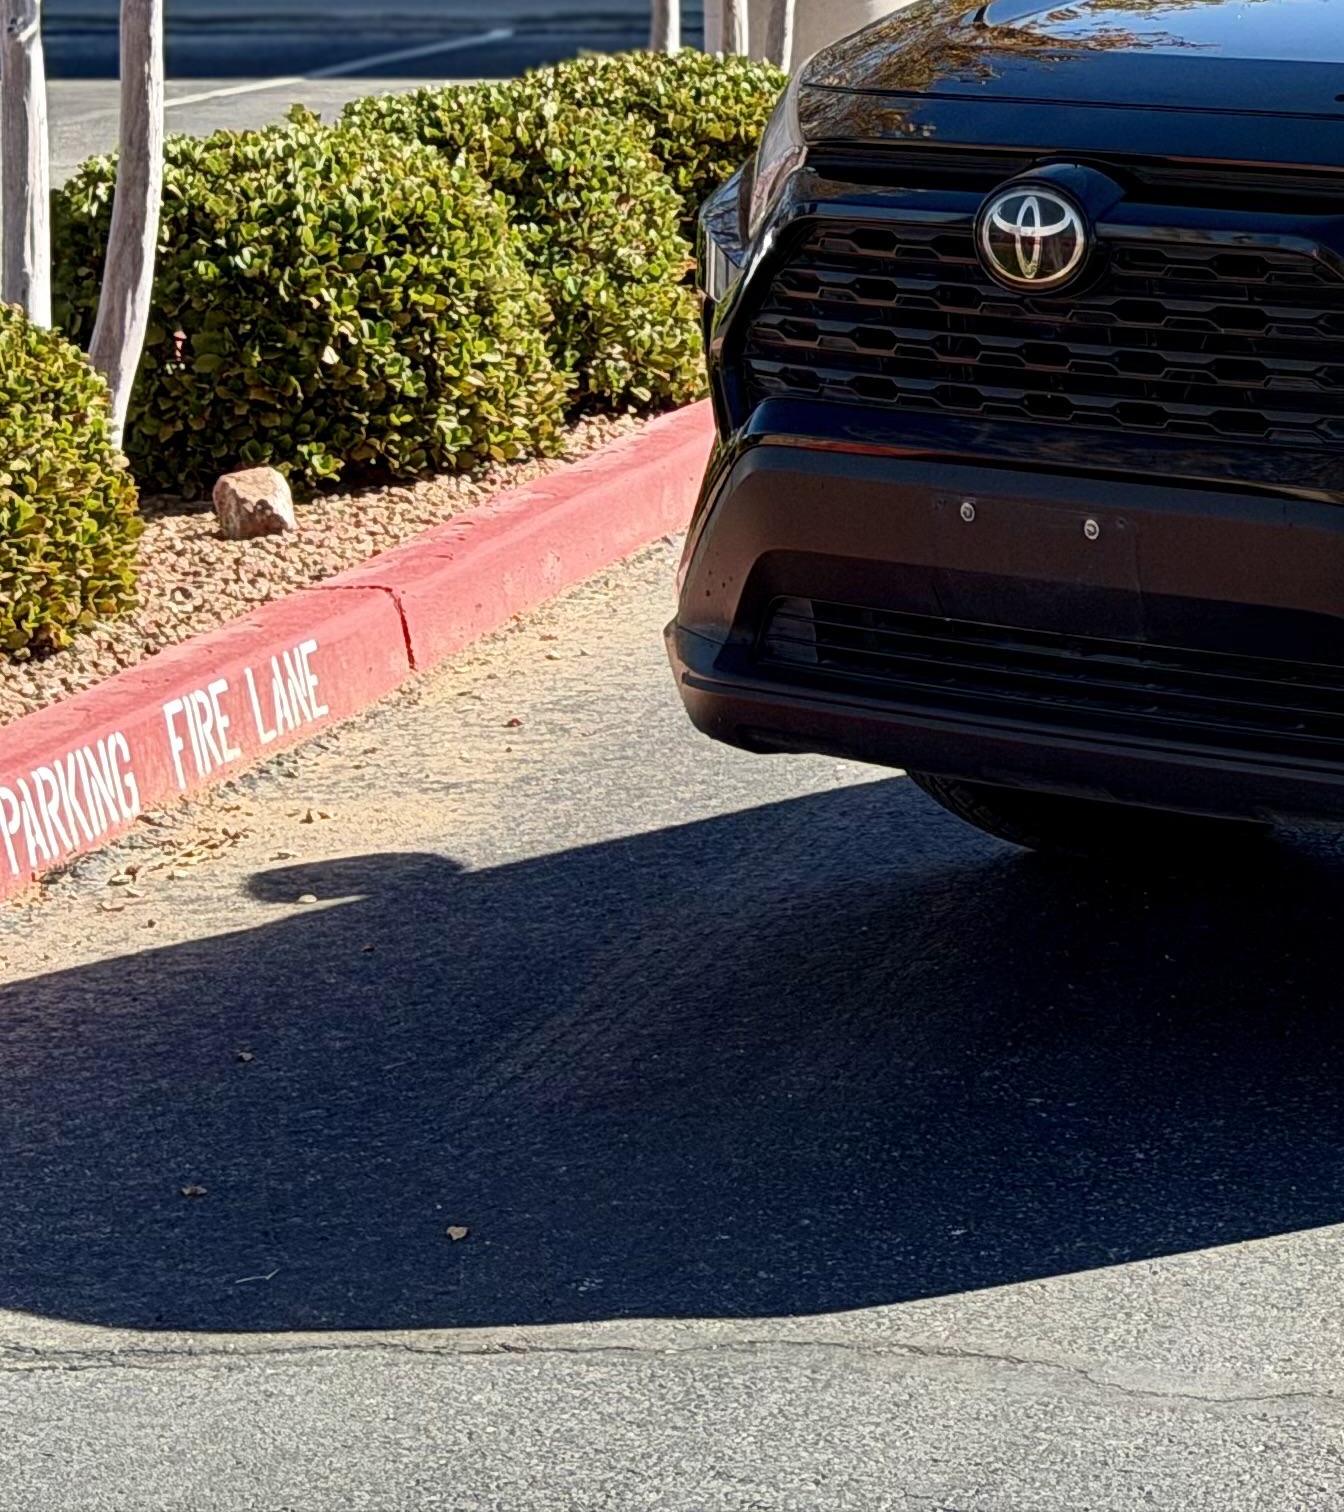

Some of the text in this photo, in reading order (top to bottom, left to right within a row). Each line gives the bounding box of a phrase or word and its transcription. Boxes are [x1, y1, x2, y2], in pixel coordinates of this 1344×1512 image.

[0, 639, 329, 875] PARKING FIRE LANE
